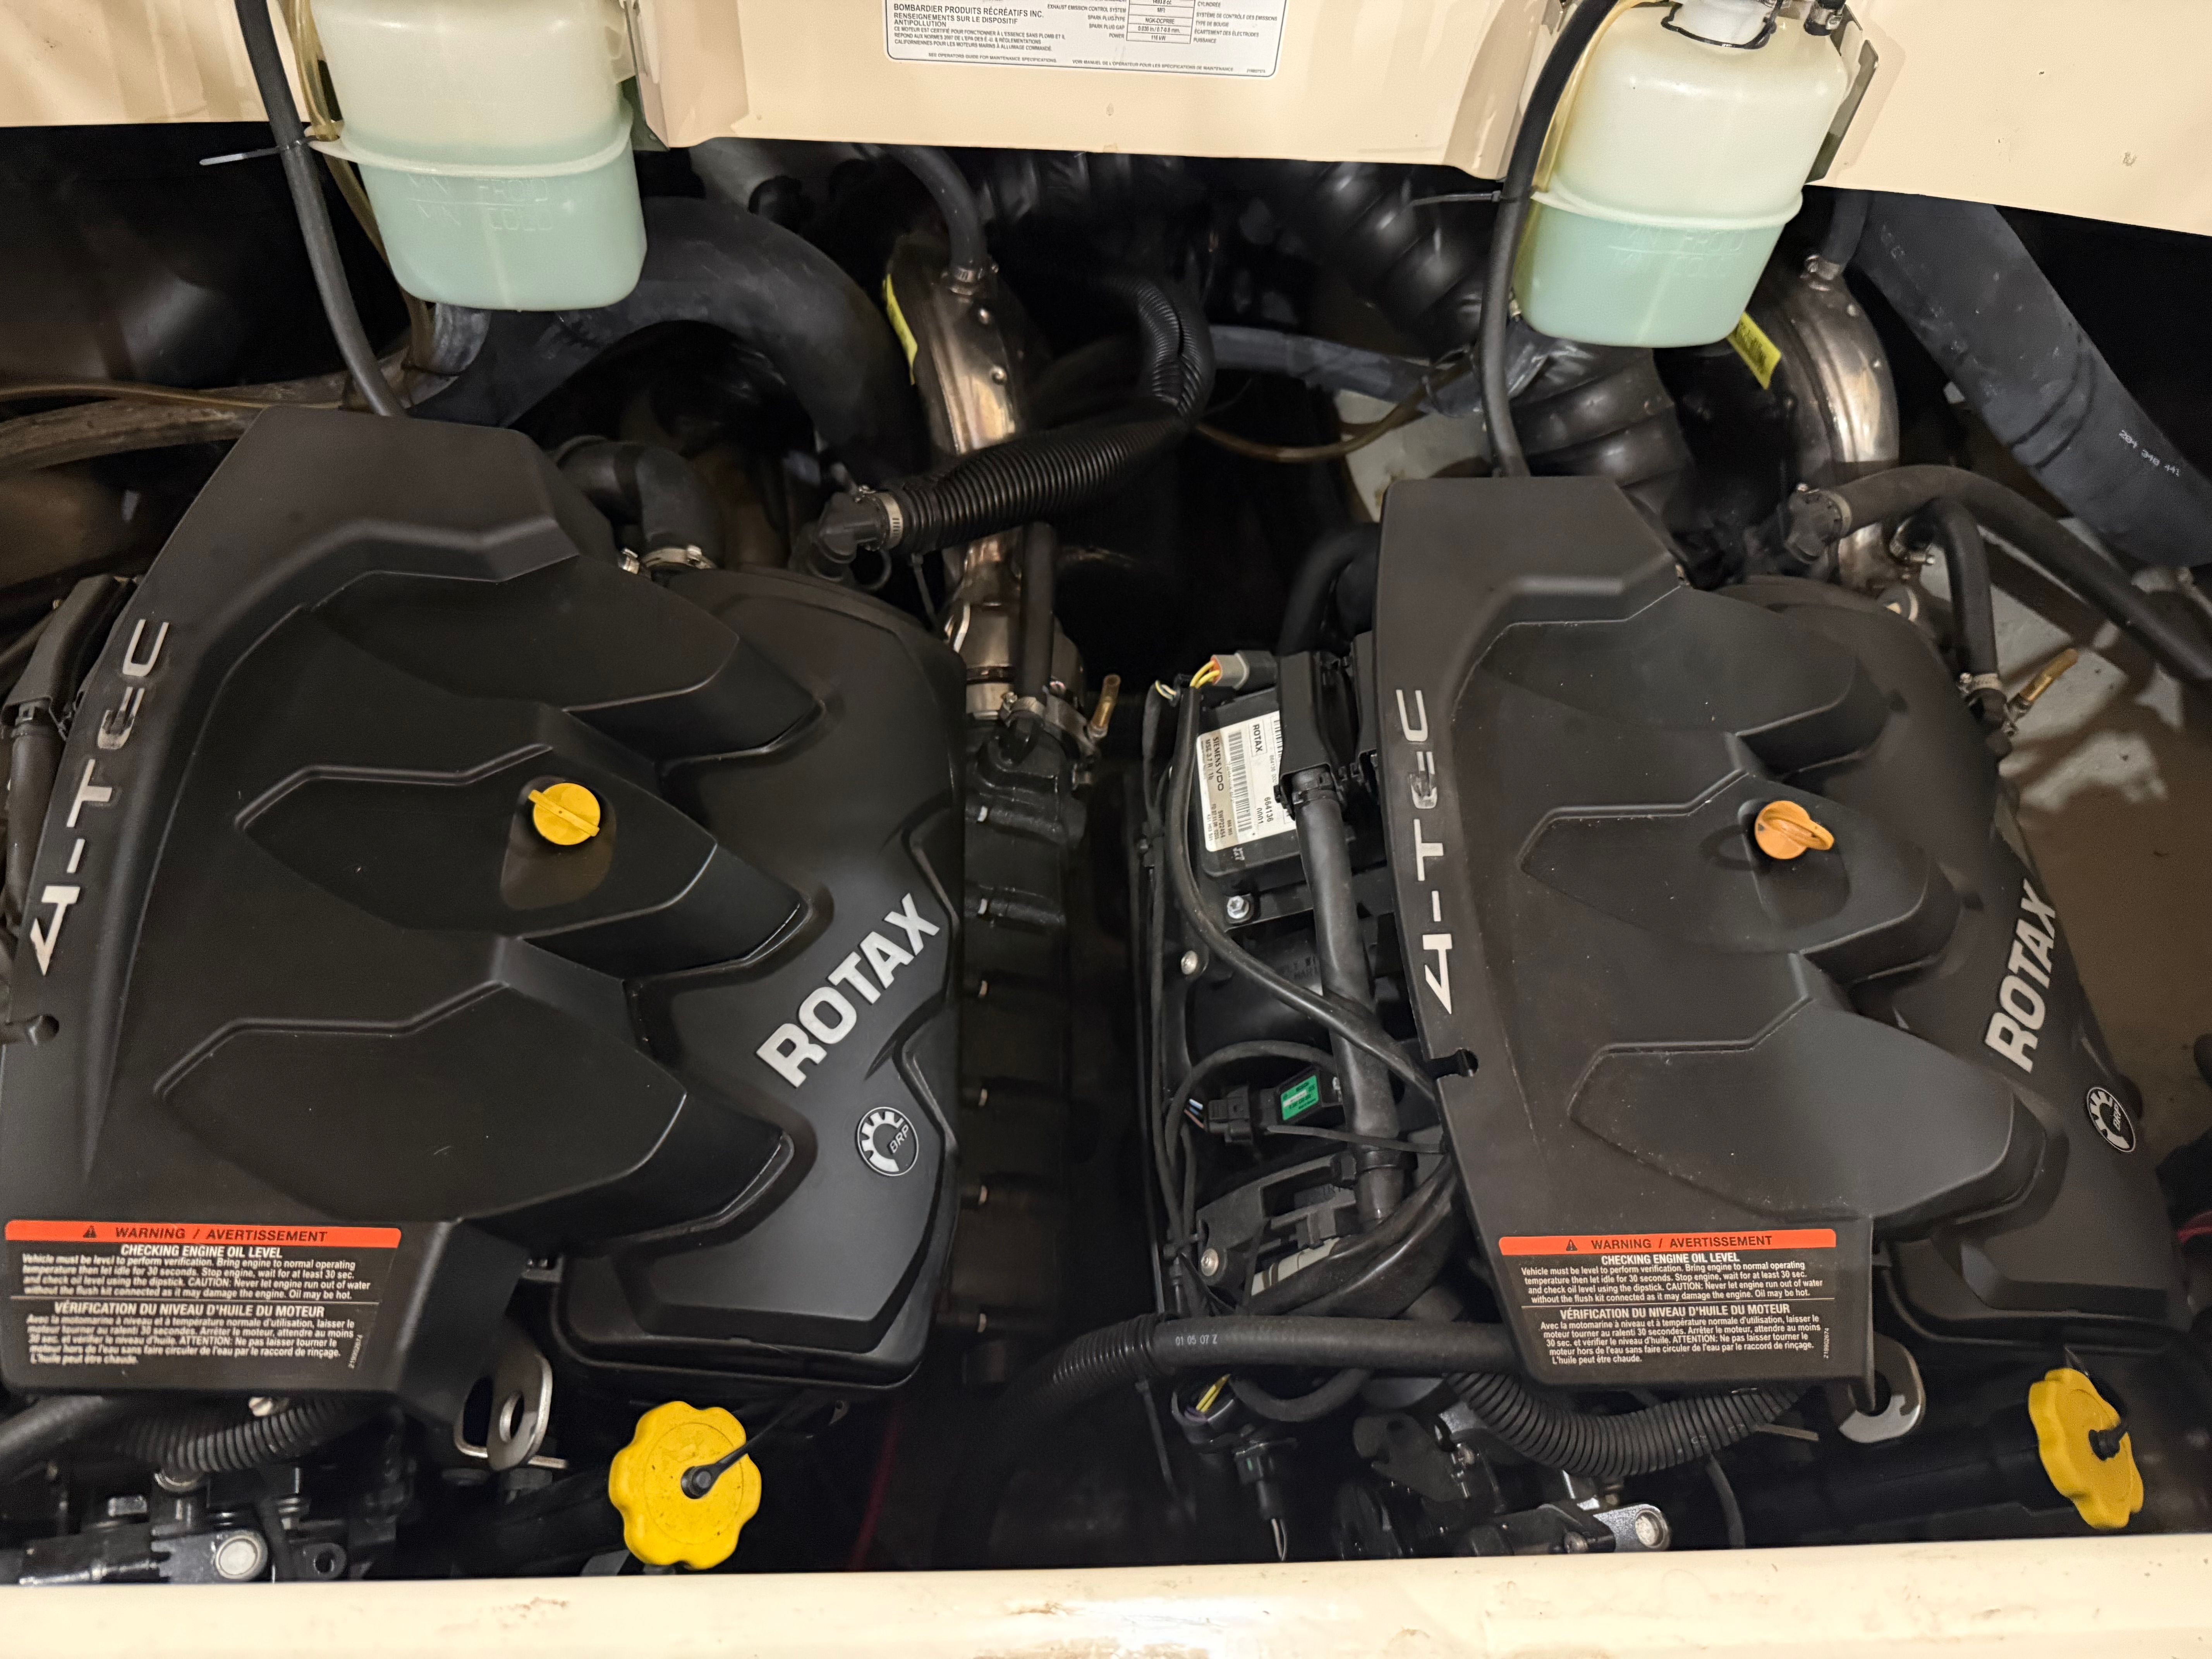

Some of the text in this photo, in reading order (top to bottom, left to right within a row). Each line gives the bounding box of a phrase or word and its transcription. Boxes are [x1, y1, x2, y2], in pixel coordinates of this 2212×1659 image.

[894, 3, 942, 12] BOMBARDIER
[945, 6, 981, 14] PRODUITS
[983, 6, 1027, 17] RÉCRÉATIFS
[894, 12, 955, 21] RENSEIGNEMENTS
[894, 19, 946, 27] ANTIPOLLUTION
[1252, 723, 1263, 753] ROTAX
[1213, 737, 1224, 791] SIEMENS VDO
[1264, 796, 1274, 822] 664136
[1984, 878, 2056, 1073] ROTAX
[756, 892, 940, 1088] ROTAX
[890, 1125, 909, 1153] BRP
[115, 1227, 186, 1239] WARNING
[205, 1229, 328, 1242] AVERTISSEMENT
[1590, 1238, 1652, 1250] WARNING
[1668, 1235, 1772, 1248] AVERTISSEMENT
[120, 1244, 284, 1258] CHECKING ENGINE OIL LEVEL
[1600, 1252, 1740, 1265] CHECKING ENGINE OIL LEVEL
[1521, 1267, 1549, 1276] Vehicle
[1599, 1266, 1609, 1274] to
[1609, 1265, 1640, 1275] perform
[1640, 1264, 1683, 1273] verification.
[1685, 1264, 1706, 1273] Bring
[1706, 1263, 1732, 1273] engine
[1742, 1262, 1769, 1270] normal
[1770, 1261, 1805, 1271] operating
[1523, 1277, 1571, 1286] temperature
[1639, 1274, 1673, 1282] seconds.
[1674, 1273, 1693, 1282] Stop
[1693, 1273, 1722, 1282] engine,
[1596, 1285, 1619, 1294] using
[1632, 1283, 1665, 1293] dipstick.
[1665, 1283, 1704, 1291] CAUTION:
[1738, 1281, 1764, 1290] engine
[54, 1299, 326, 1317] VÉRIFICATION DU NIVEAU D'HUILE DU MOTEUR
[1559, 1303, 1790, 1320] VÉRIFICATION DU NIVEAU D'HUILE DU MOTEUR
[1175, 1336, 1183, 1346] 01
[1200, 1334, 1209, 1345] 07
[1577, 1357, 1596, 1365] peut
